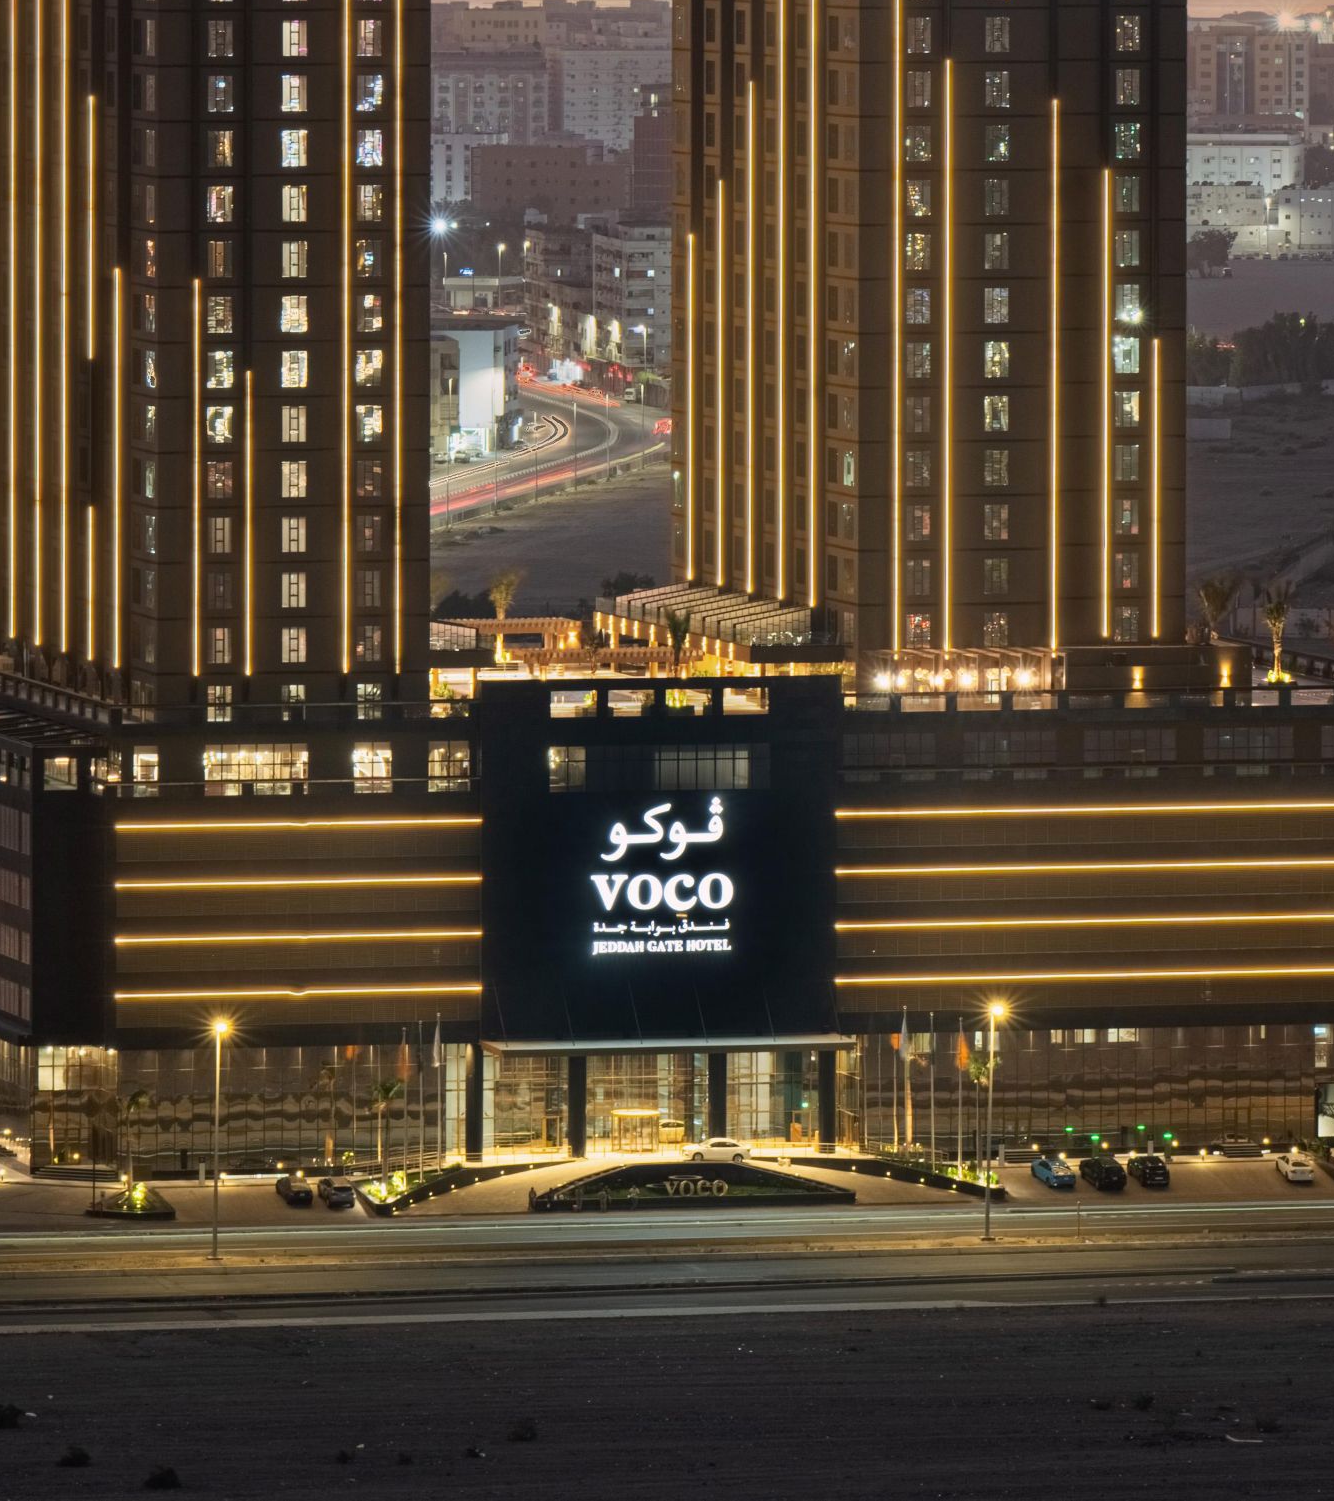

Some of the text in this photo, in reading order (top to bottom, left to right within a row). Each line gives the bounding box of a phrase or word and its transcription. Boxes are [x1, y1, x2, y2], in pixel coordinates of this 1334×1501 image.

[593, 918, 730, 936] فندق بوابة جدة
[592, 938, 732, 955] JEDDAH GATE HOTEL
